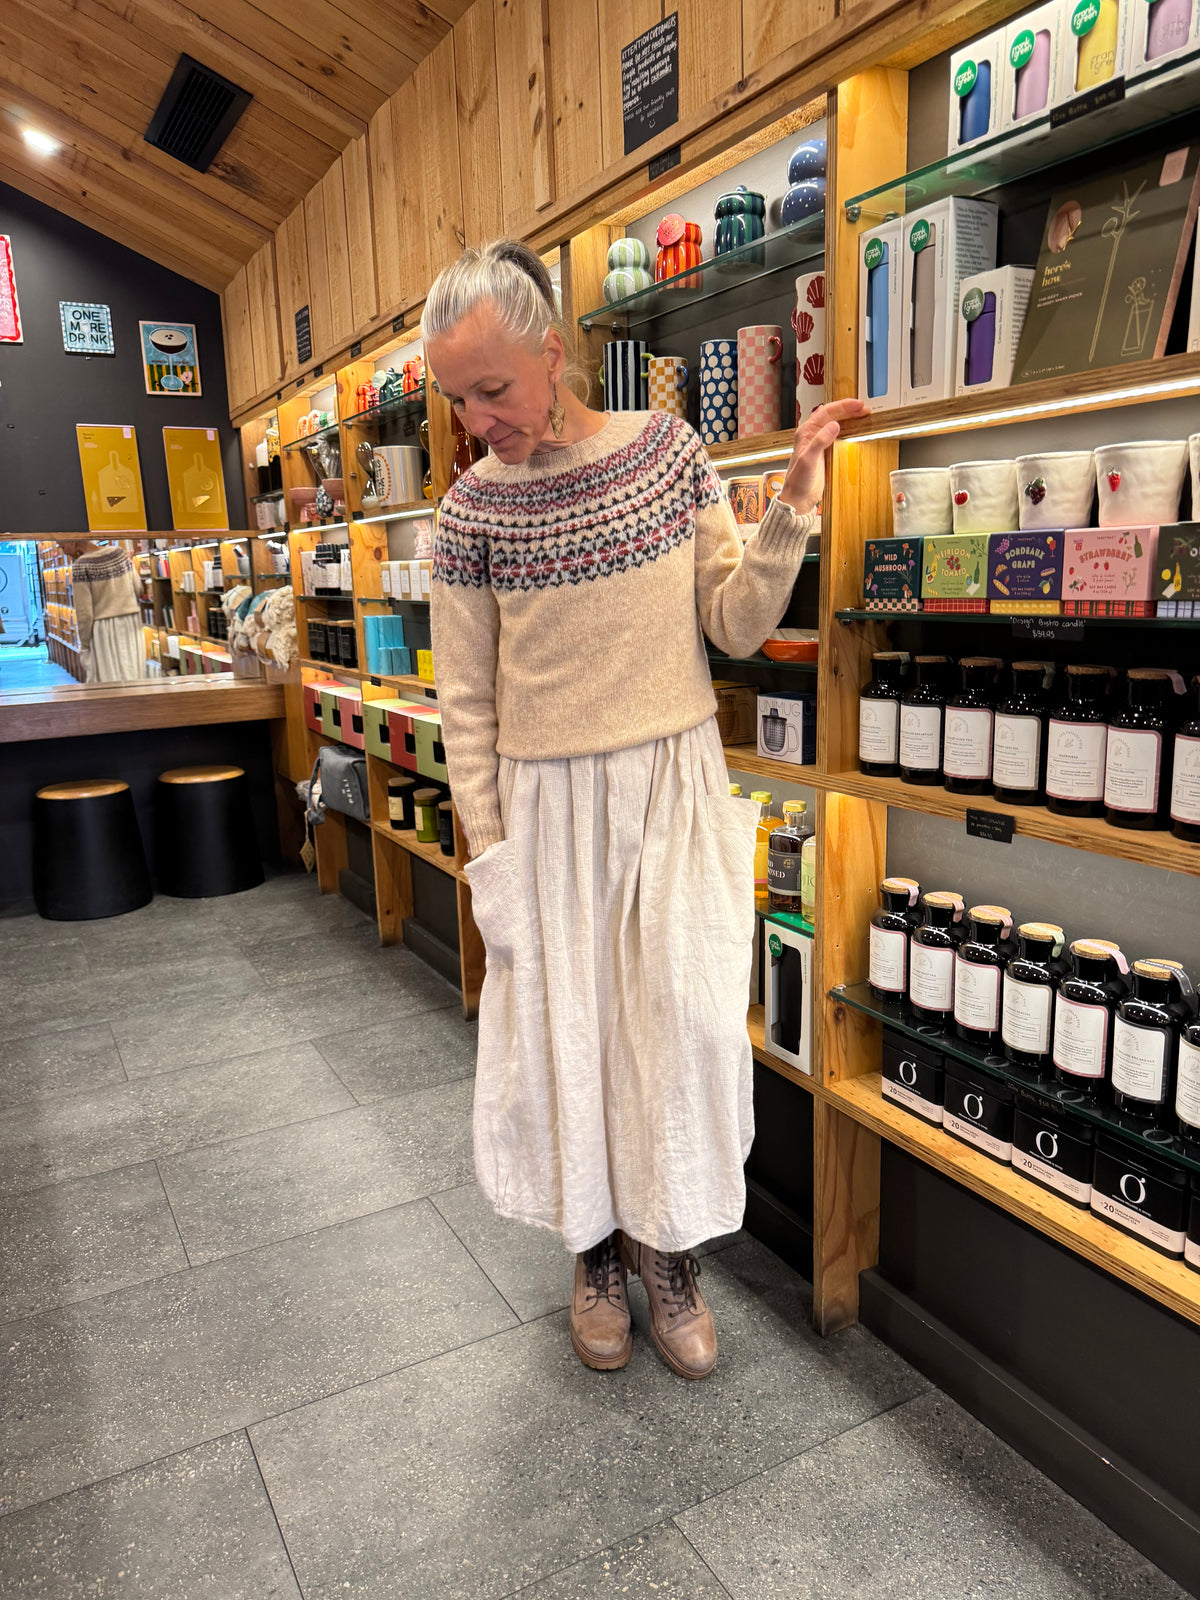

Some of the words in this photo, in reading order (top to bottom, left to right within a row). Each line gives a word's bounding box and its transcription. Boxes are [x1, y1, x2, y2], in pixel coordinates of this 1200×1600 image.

[1090, 50, 1115, 70] fran
[1041, 275, 1061, 288] how
[72, 310, 101, 321] ONE
[884, 553, 898, 561] WILD
[935, 548, 970, 560] HEIRLOOM
[1005, 547, 1045, 560] BORDEAUX
[1079, 548, 1132, 564] STRAWBERRY
[874, 564, 907, 572] MUSHROOM
[1012, 560, 1035, 568] GRAPE
[941, 567, 967, 577] TOMATO
[1038, 619, 1059, 627] Bistro
[759, 699, 801, 717] UNIMUG
[890, 1085, 898, 1095] 20
[951, 1120, 960, 1130] 20
[1023, 1158, 1033, 1169] 20
[1103, 1202, 1115, 1213] 20
